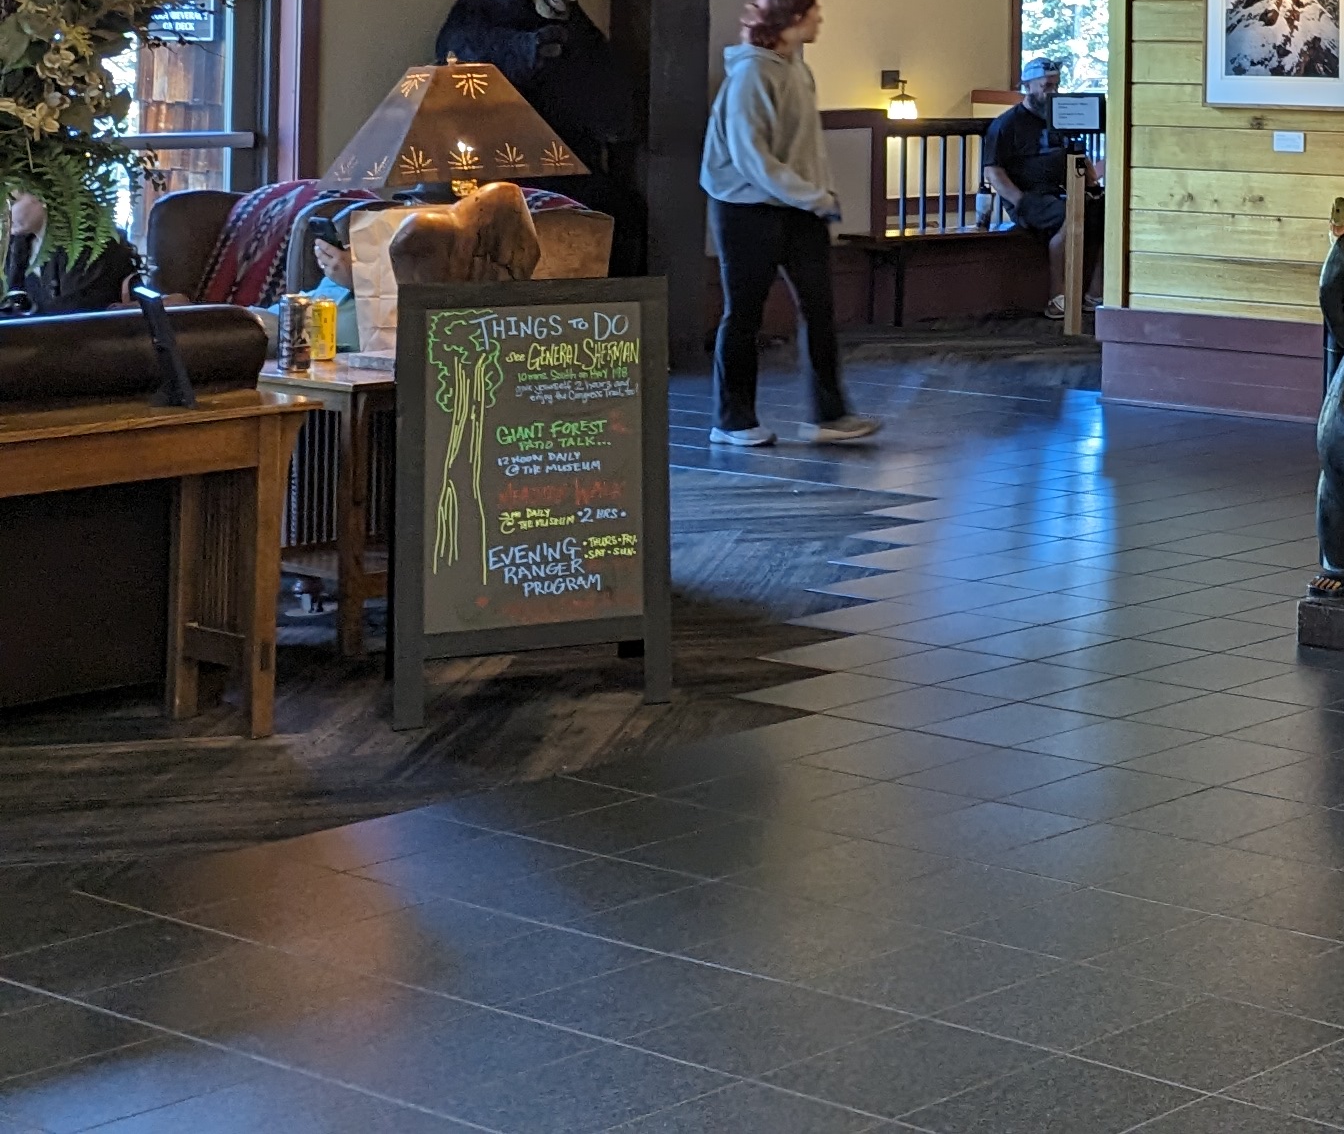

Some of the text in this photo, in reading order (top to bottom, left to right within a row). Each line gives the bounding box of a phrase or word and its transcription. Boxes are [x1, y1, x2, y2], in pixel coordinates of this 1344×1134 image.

[469, 313, 563, 350] THINGS
[593, 311, 629, 340] DO
[527, 342, 582, 371] GENERAL
[582, 338, 640, 370] SHERMAN
[496, 419, 608, 445] GIANT FOREST
[497, 456, 510, 466] 12
[548, 451, 581, 462] DAILY
[545, 460, 601, 474] MUSEUM
[488, 537, 581, 570] EVENING
[504, 558, 585, 585] RANGER
[522, 573, 602, 598] PROGRAM
